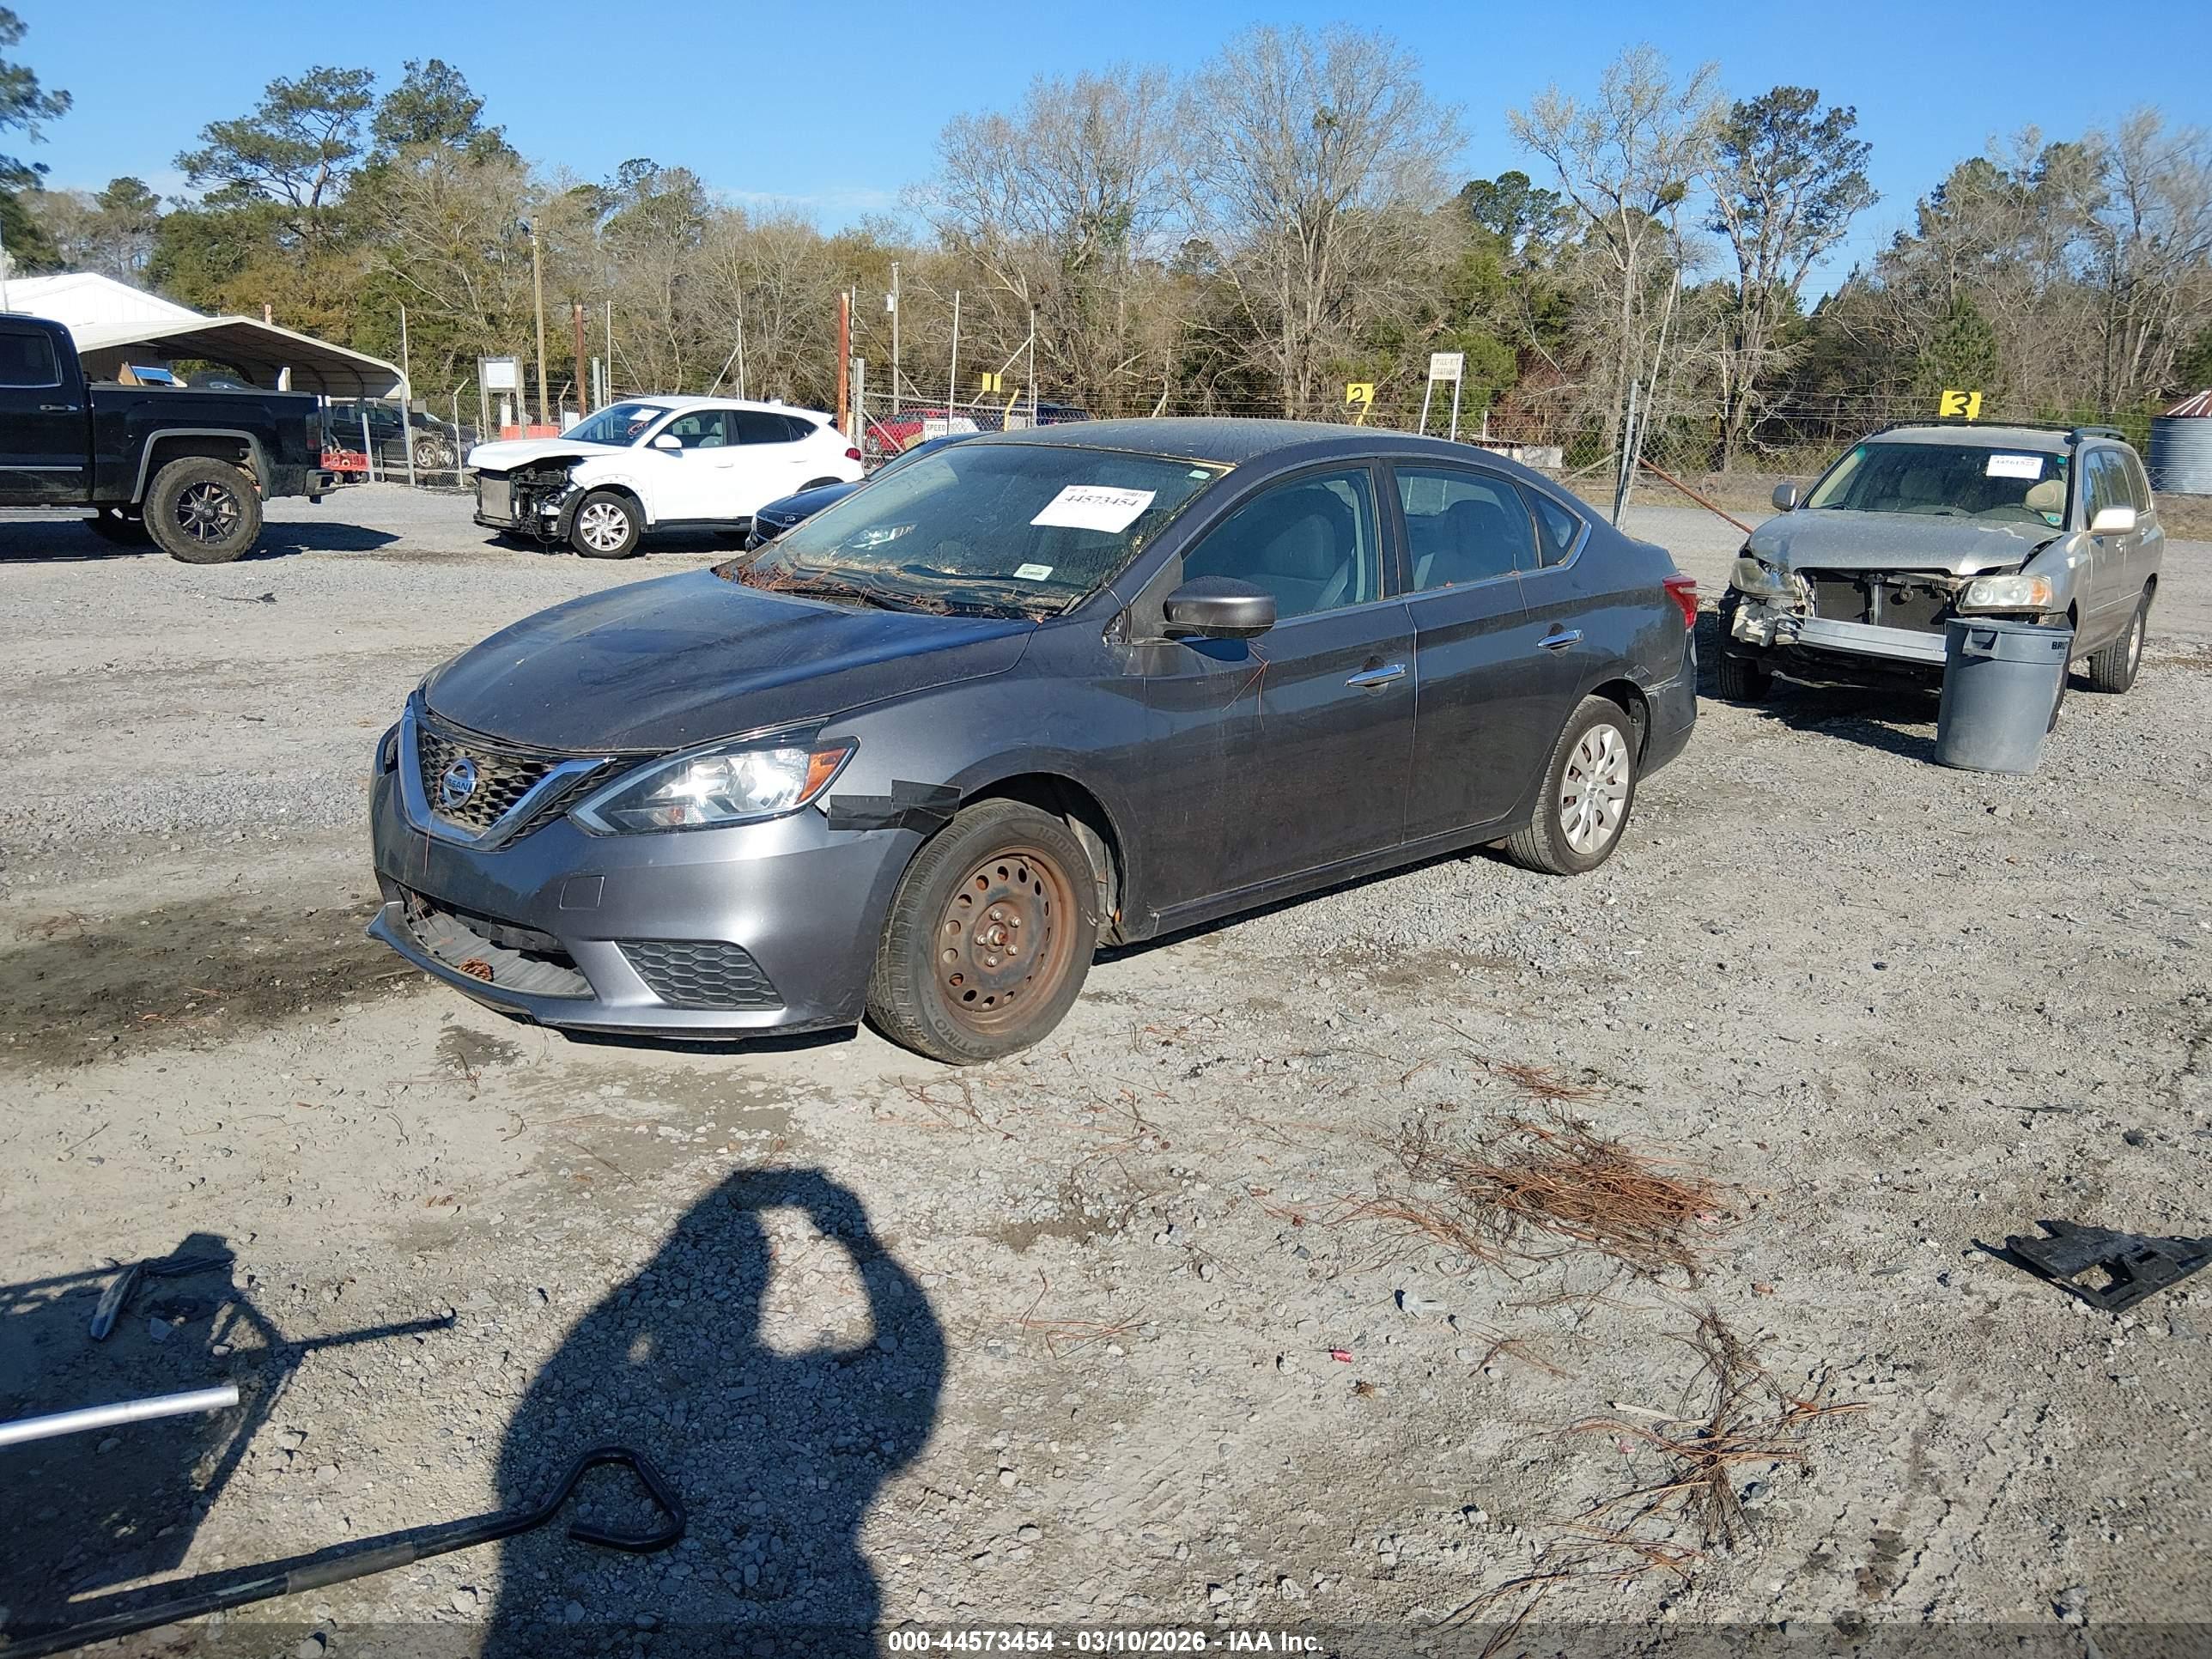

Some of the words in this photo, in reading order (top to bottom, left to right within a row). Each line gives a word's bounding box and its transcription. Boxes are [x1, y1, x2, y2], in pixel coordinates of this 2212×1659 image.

[1431, 368, 1457, 376] STATION
[1348, 386, 1367, 404] 2
[1949, 392, 1972, 417] 3
[1065, 495, 1139, 507] 44573454
